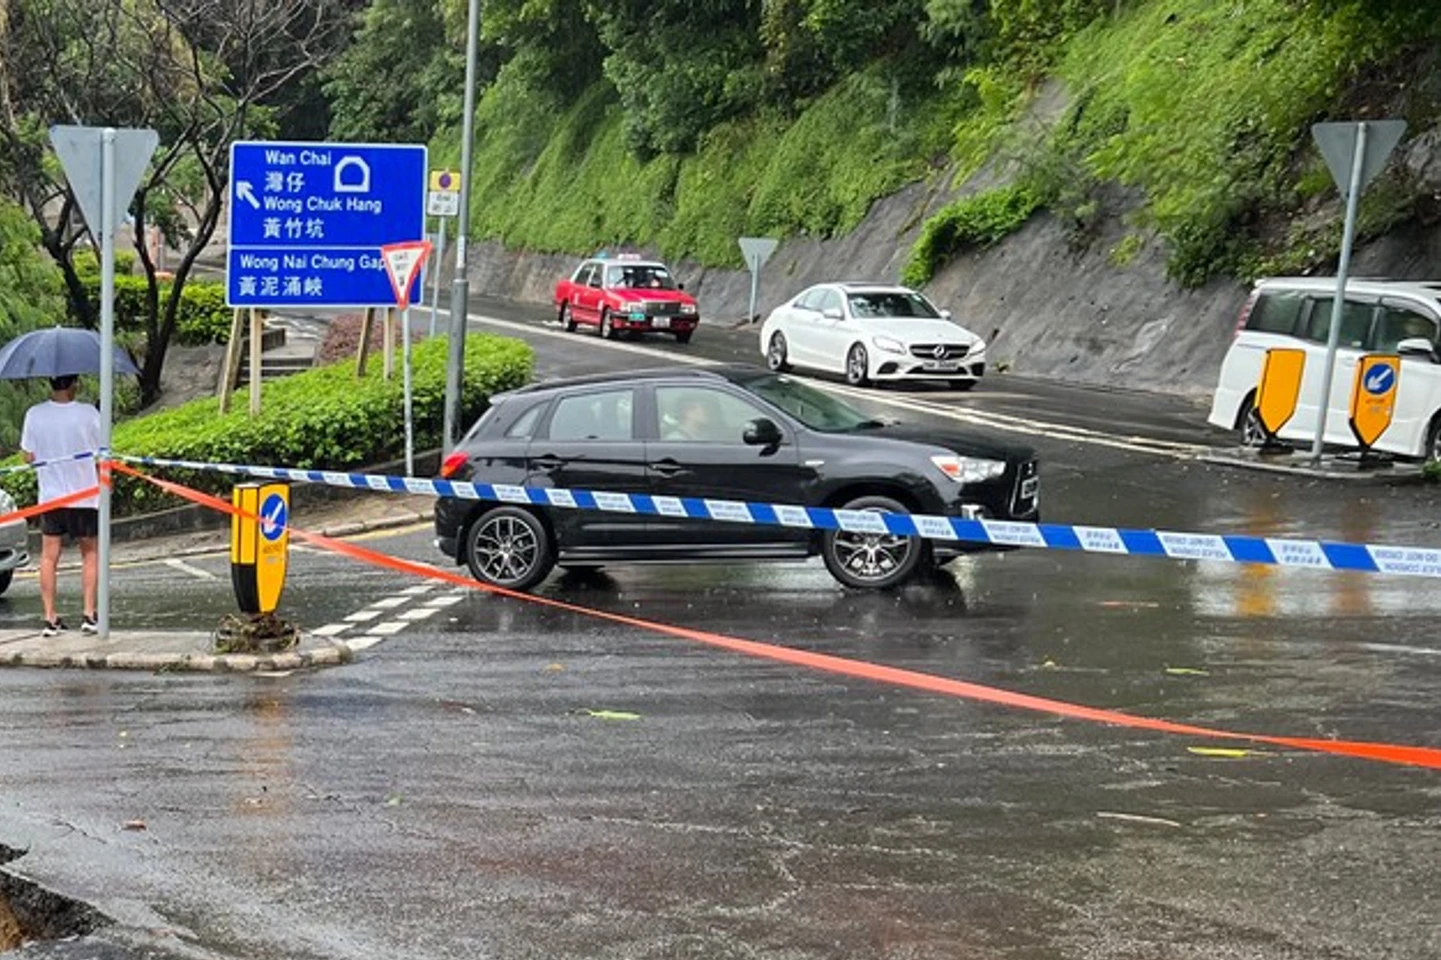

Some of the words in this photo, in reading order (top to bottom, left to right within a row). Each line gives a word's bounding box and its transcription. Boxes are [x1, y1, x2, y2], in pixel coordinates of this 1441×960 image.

[264, 149, 297, 165] Wan
[300, 149, 332, 165] Chai
[263, 170, 306, 193] 灣仔
[262, 195, 303, 214] Wong
[306, 195, 343, 211] Chuk
[346, 196, 382, 214] Hang
[262, 216, 325, 239] 黃竹坑
[239, 253, 279, 272] Wong
[283, 253, 308, 269] Nai
[311, 253, 355, 272] Chung
[359, 253, 387, 272] Gap
